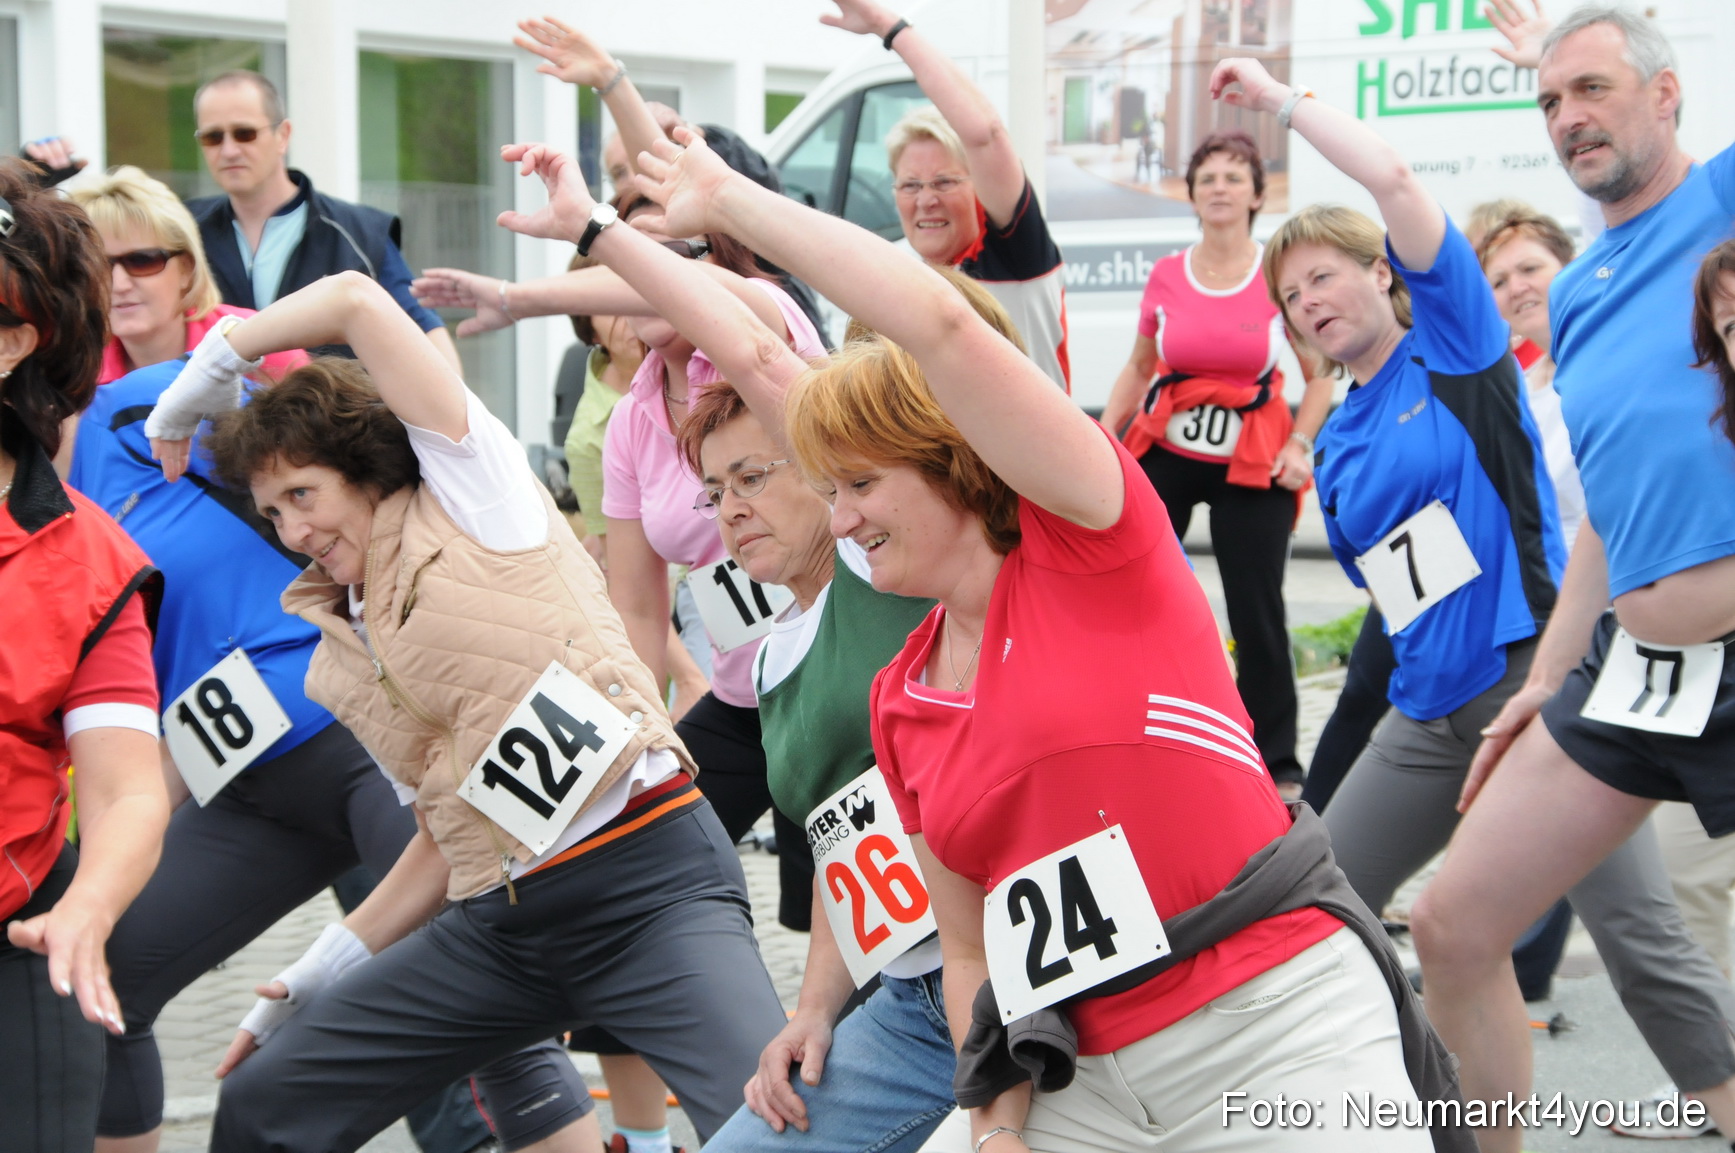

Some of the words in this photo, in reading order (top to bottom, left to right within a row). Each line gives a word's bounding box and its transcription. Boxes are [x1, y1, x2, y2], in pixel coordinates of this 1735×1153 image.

[1183, 404, 1229, 446] 30
[712, 558, 774, 627] 17
[1388, 530, 1427, 602] 7
[176, 676, 254, 769] 18
[481, 690, 606, 821] 124
[808, 808, 842, 849] EYER
[813, 824, 850, 864] ERBUNG
[825, 833, 930, 956] 26
[1007, 854, 1119, 991] 24
